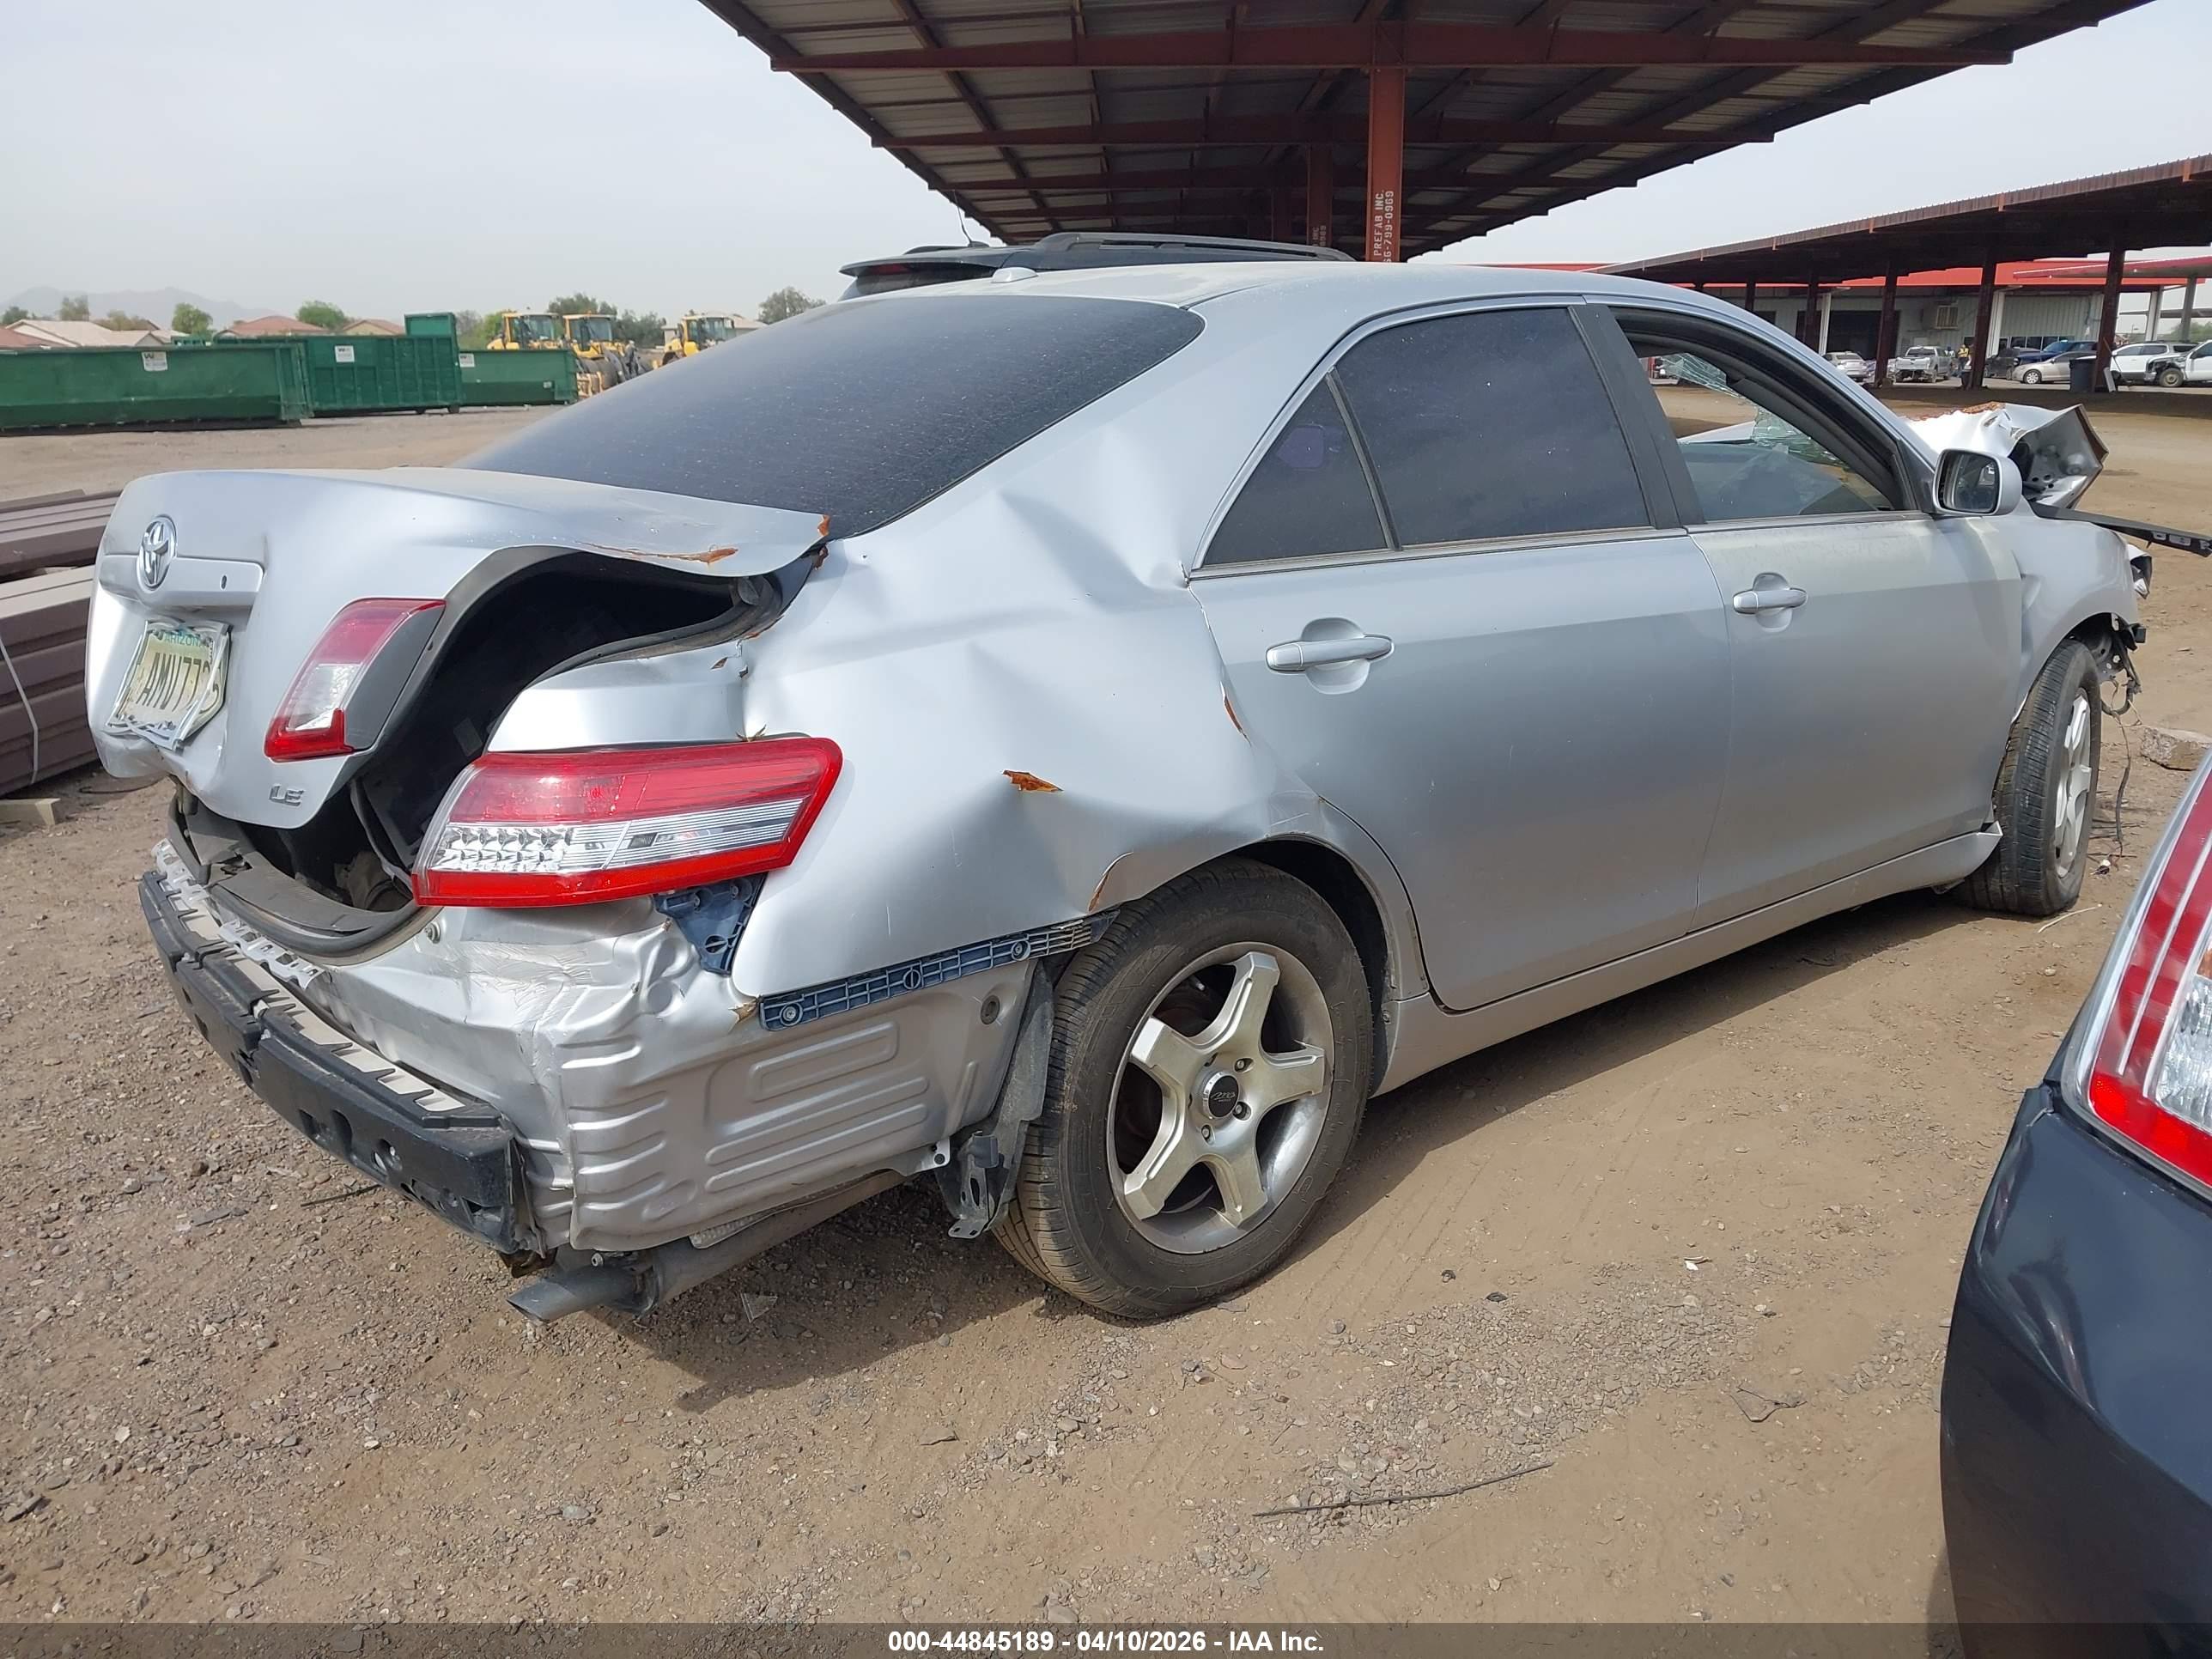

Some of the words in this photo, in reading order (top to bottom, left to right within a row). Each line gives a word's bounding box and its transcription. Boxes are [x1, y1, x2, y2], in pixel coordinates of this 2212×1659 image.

[1375, 190, 1384, 210] INC.
[1373, 216, 1382, 256] PREFAB
[164, 634, 205, 647] ARIZON
[268, 784, 304, 807] LE
